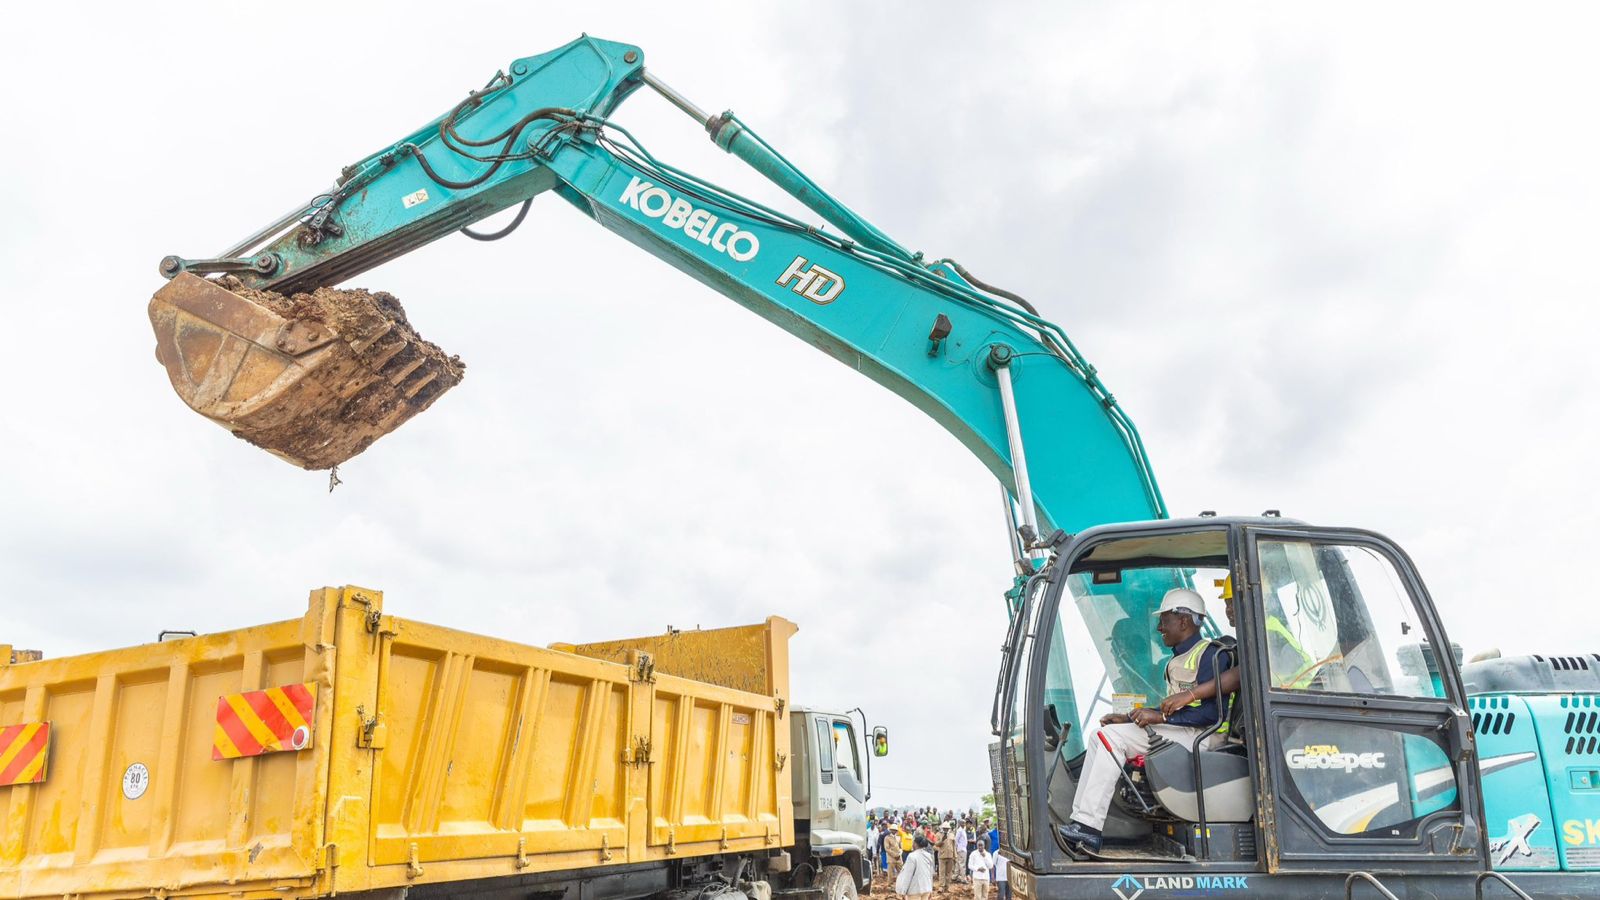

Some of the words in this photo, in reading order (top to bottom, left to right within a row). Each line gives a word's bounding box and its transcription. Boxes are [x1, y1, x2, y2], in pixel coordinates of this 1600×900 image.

[618, 176, 760, 262] KOBELCO
[775, 255, 846, 305] HD
[131, 773, 141, 784] 80
[1562, 818, 1600, 846] SK
